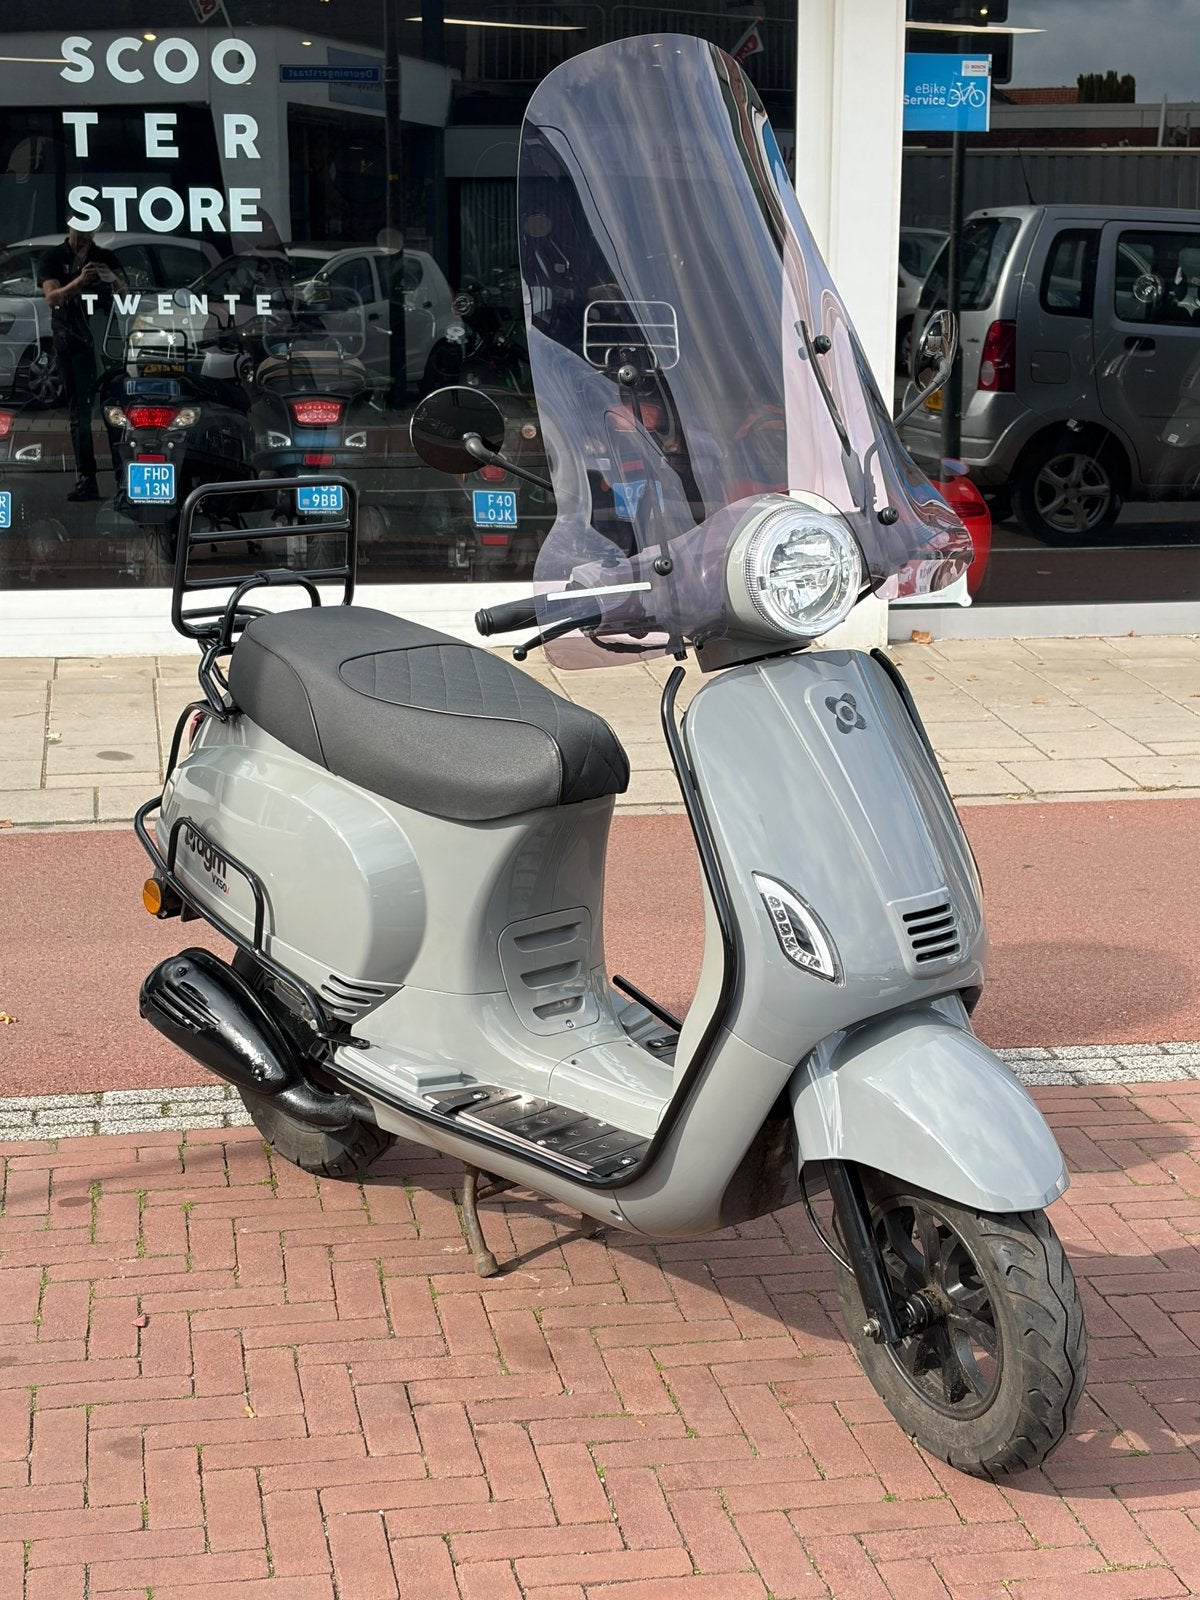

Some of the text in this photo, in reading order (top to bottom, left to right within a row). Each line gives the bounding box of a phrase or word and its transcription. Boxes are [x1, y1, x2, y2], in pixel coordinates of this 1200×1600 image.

[60, 36, 256, 85] SCOO
[915, 83, 946, 94] eBike
[903, 95, 946, 106] Service
[67, 185, 263, 232] STORE
[81, 294, 272, 316] TWENTE
[144, 467, 169, 480] FHD
[145, 483, 170, 496] 13N
[312, 494, 338, 507] 9BB
[488, 494, 512, 507] F40
